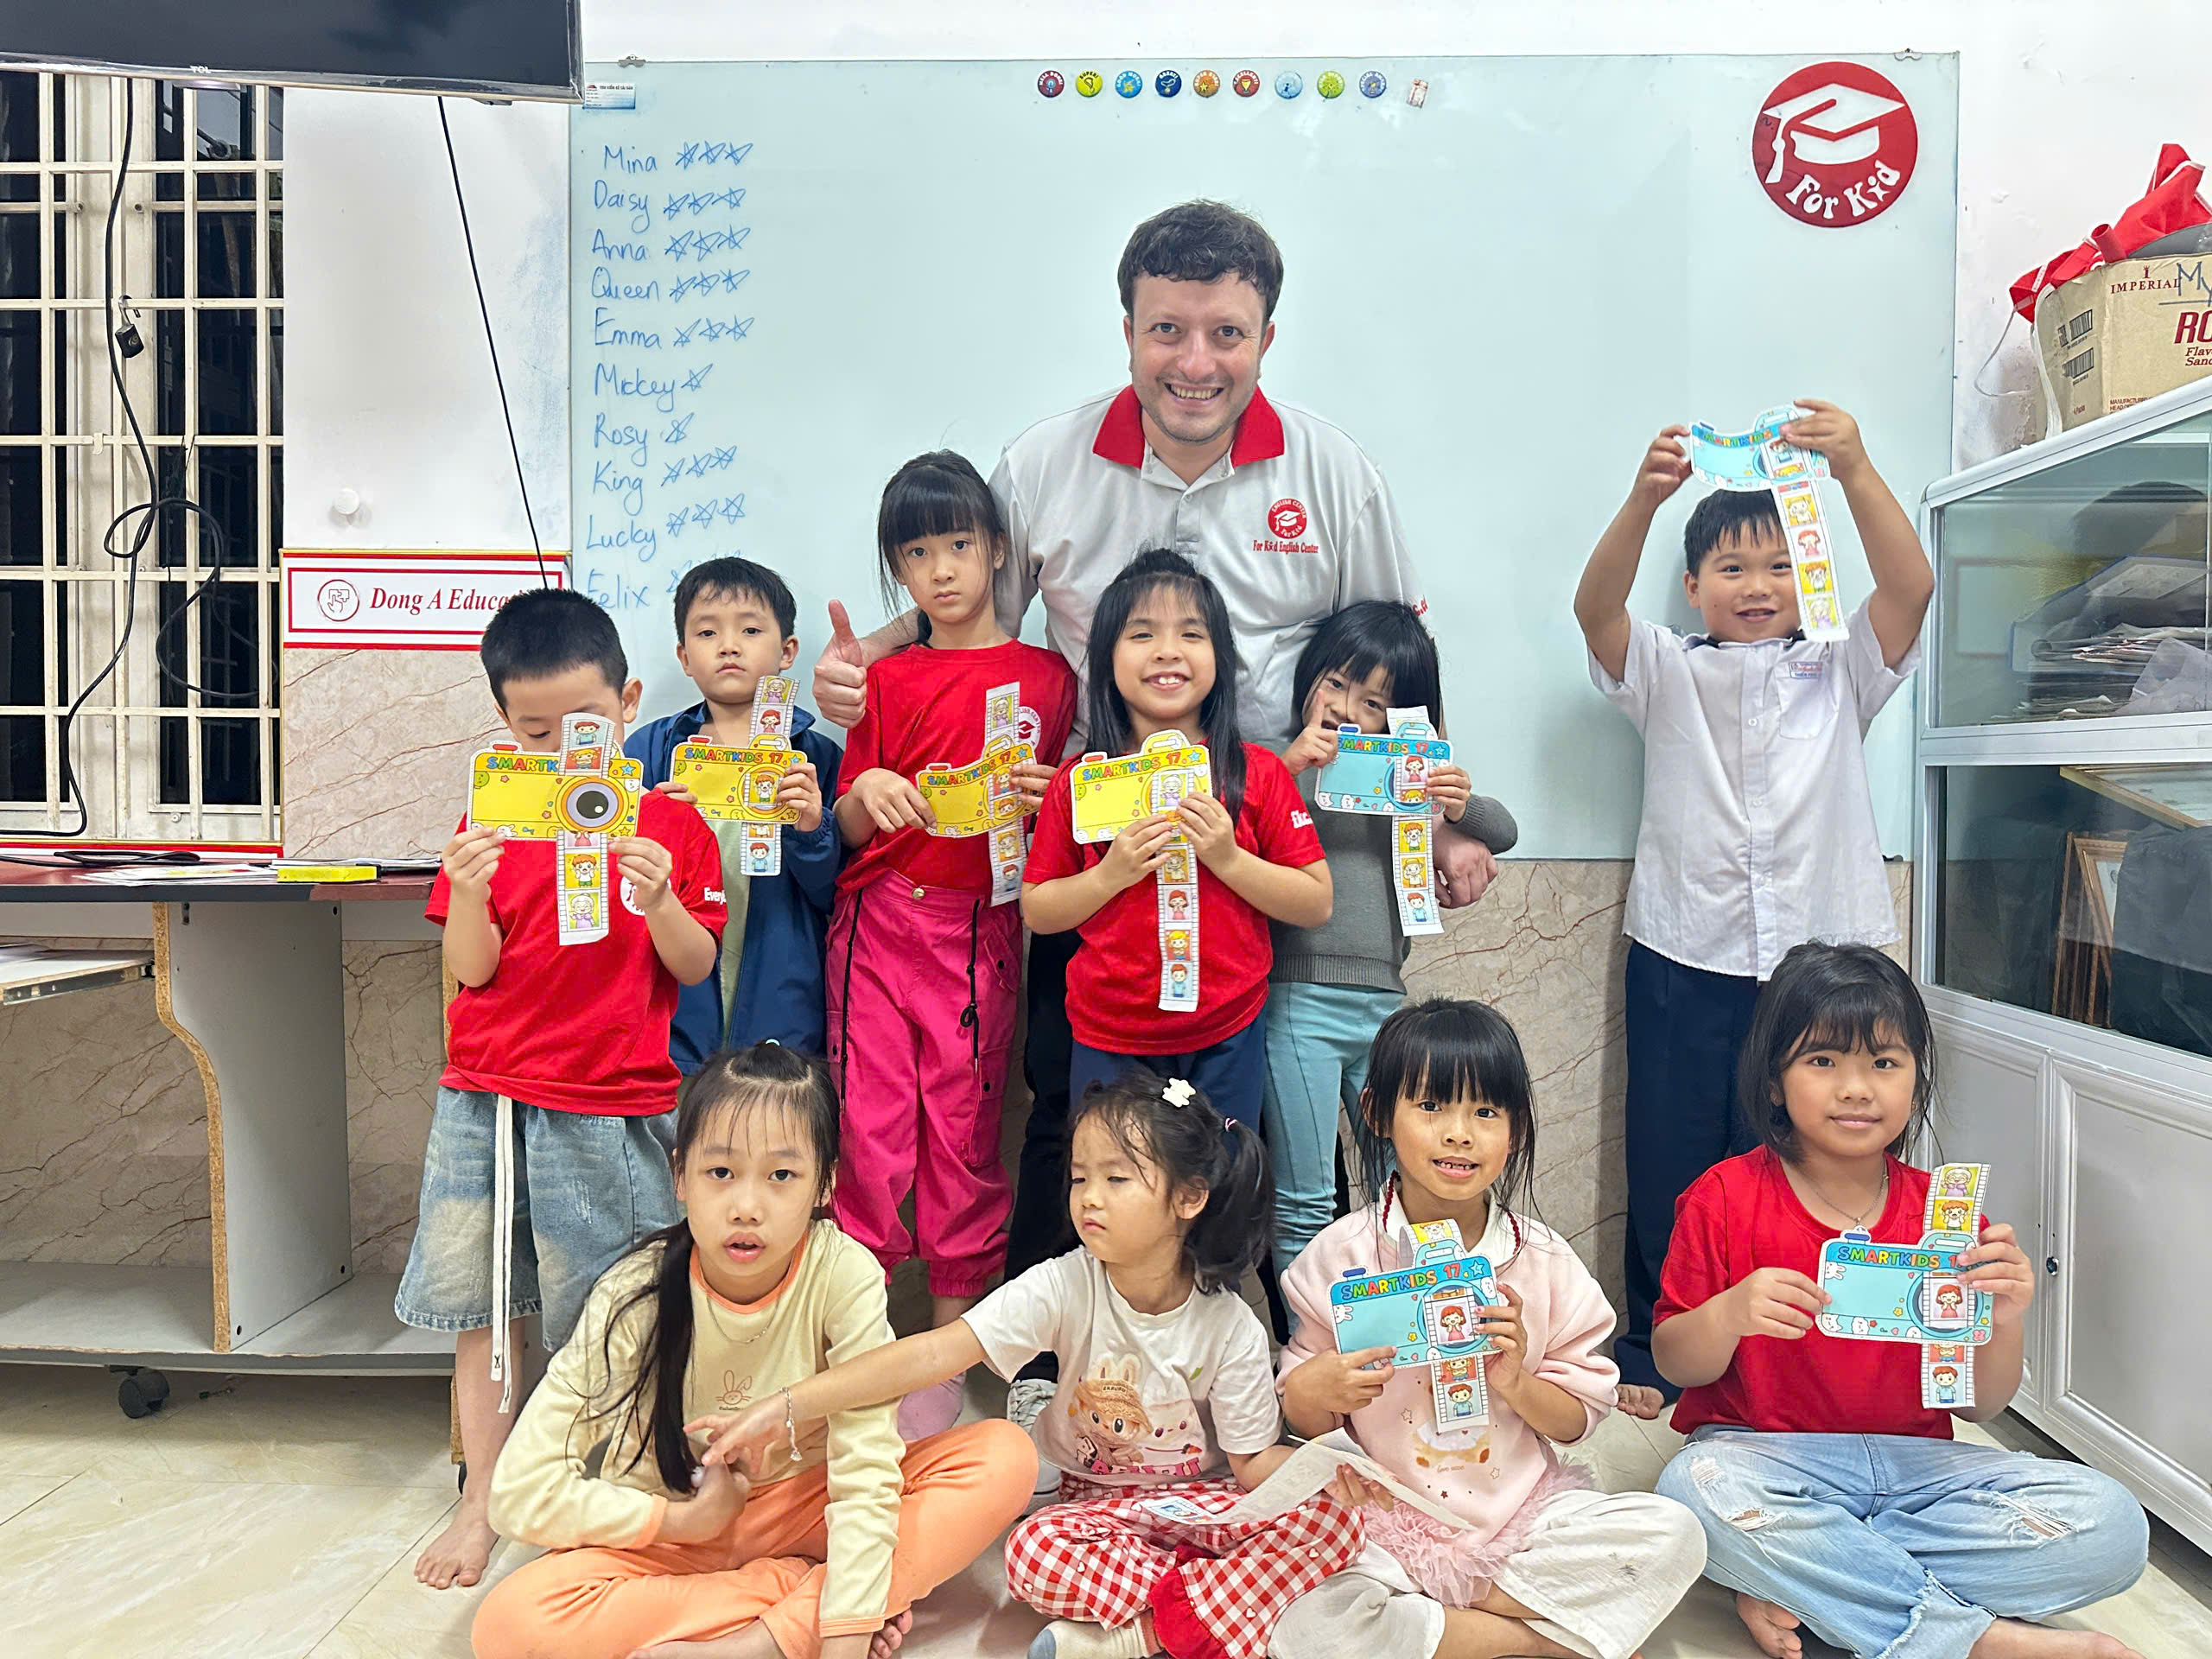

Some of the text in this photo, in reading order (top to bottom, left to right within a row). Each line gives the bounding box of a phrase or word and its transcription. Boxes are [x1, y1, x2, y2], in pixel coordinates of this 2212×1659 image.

[1079, 71, 1099, 79] SUPER!
[604, 145, 658, 173] Mina
[1785, 160, 1901, 219] For Kid
[594, 180, 650, 233] Daisy
[592, 229, 648, 261] Anna
[592, 266, 660, 302] Queen
[2111, 278, 2181, 294] IMPERIAL
[594, 307, 662, 349] Emma
[2185, 346, 2212, 357] Flav
[594, 412, 648, 467] Rosy
[593, 460, 643, 517] King
[587, 514, 657, 562] Lucky
[1253, 539, 1319, 555] For Kid English Center
[370, 588, 522, 615] Dong A Educa
[588, 568, 651, 608] Felix
[486, 756, 558, 772] SMARTK
[684, 747, 764, 764] SMARTKIDS
[1083, 757, 1160, 780] SMARTKIDS
[927, 760, 996, 785] SMARTKIDS
[1838, 1246, 1941, 1269] SMARTKIDS
[1341, 1270, 1438, 1300] SMARTKIDS
